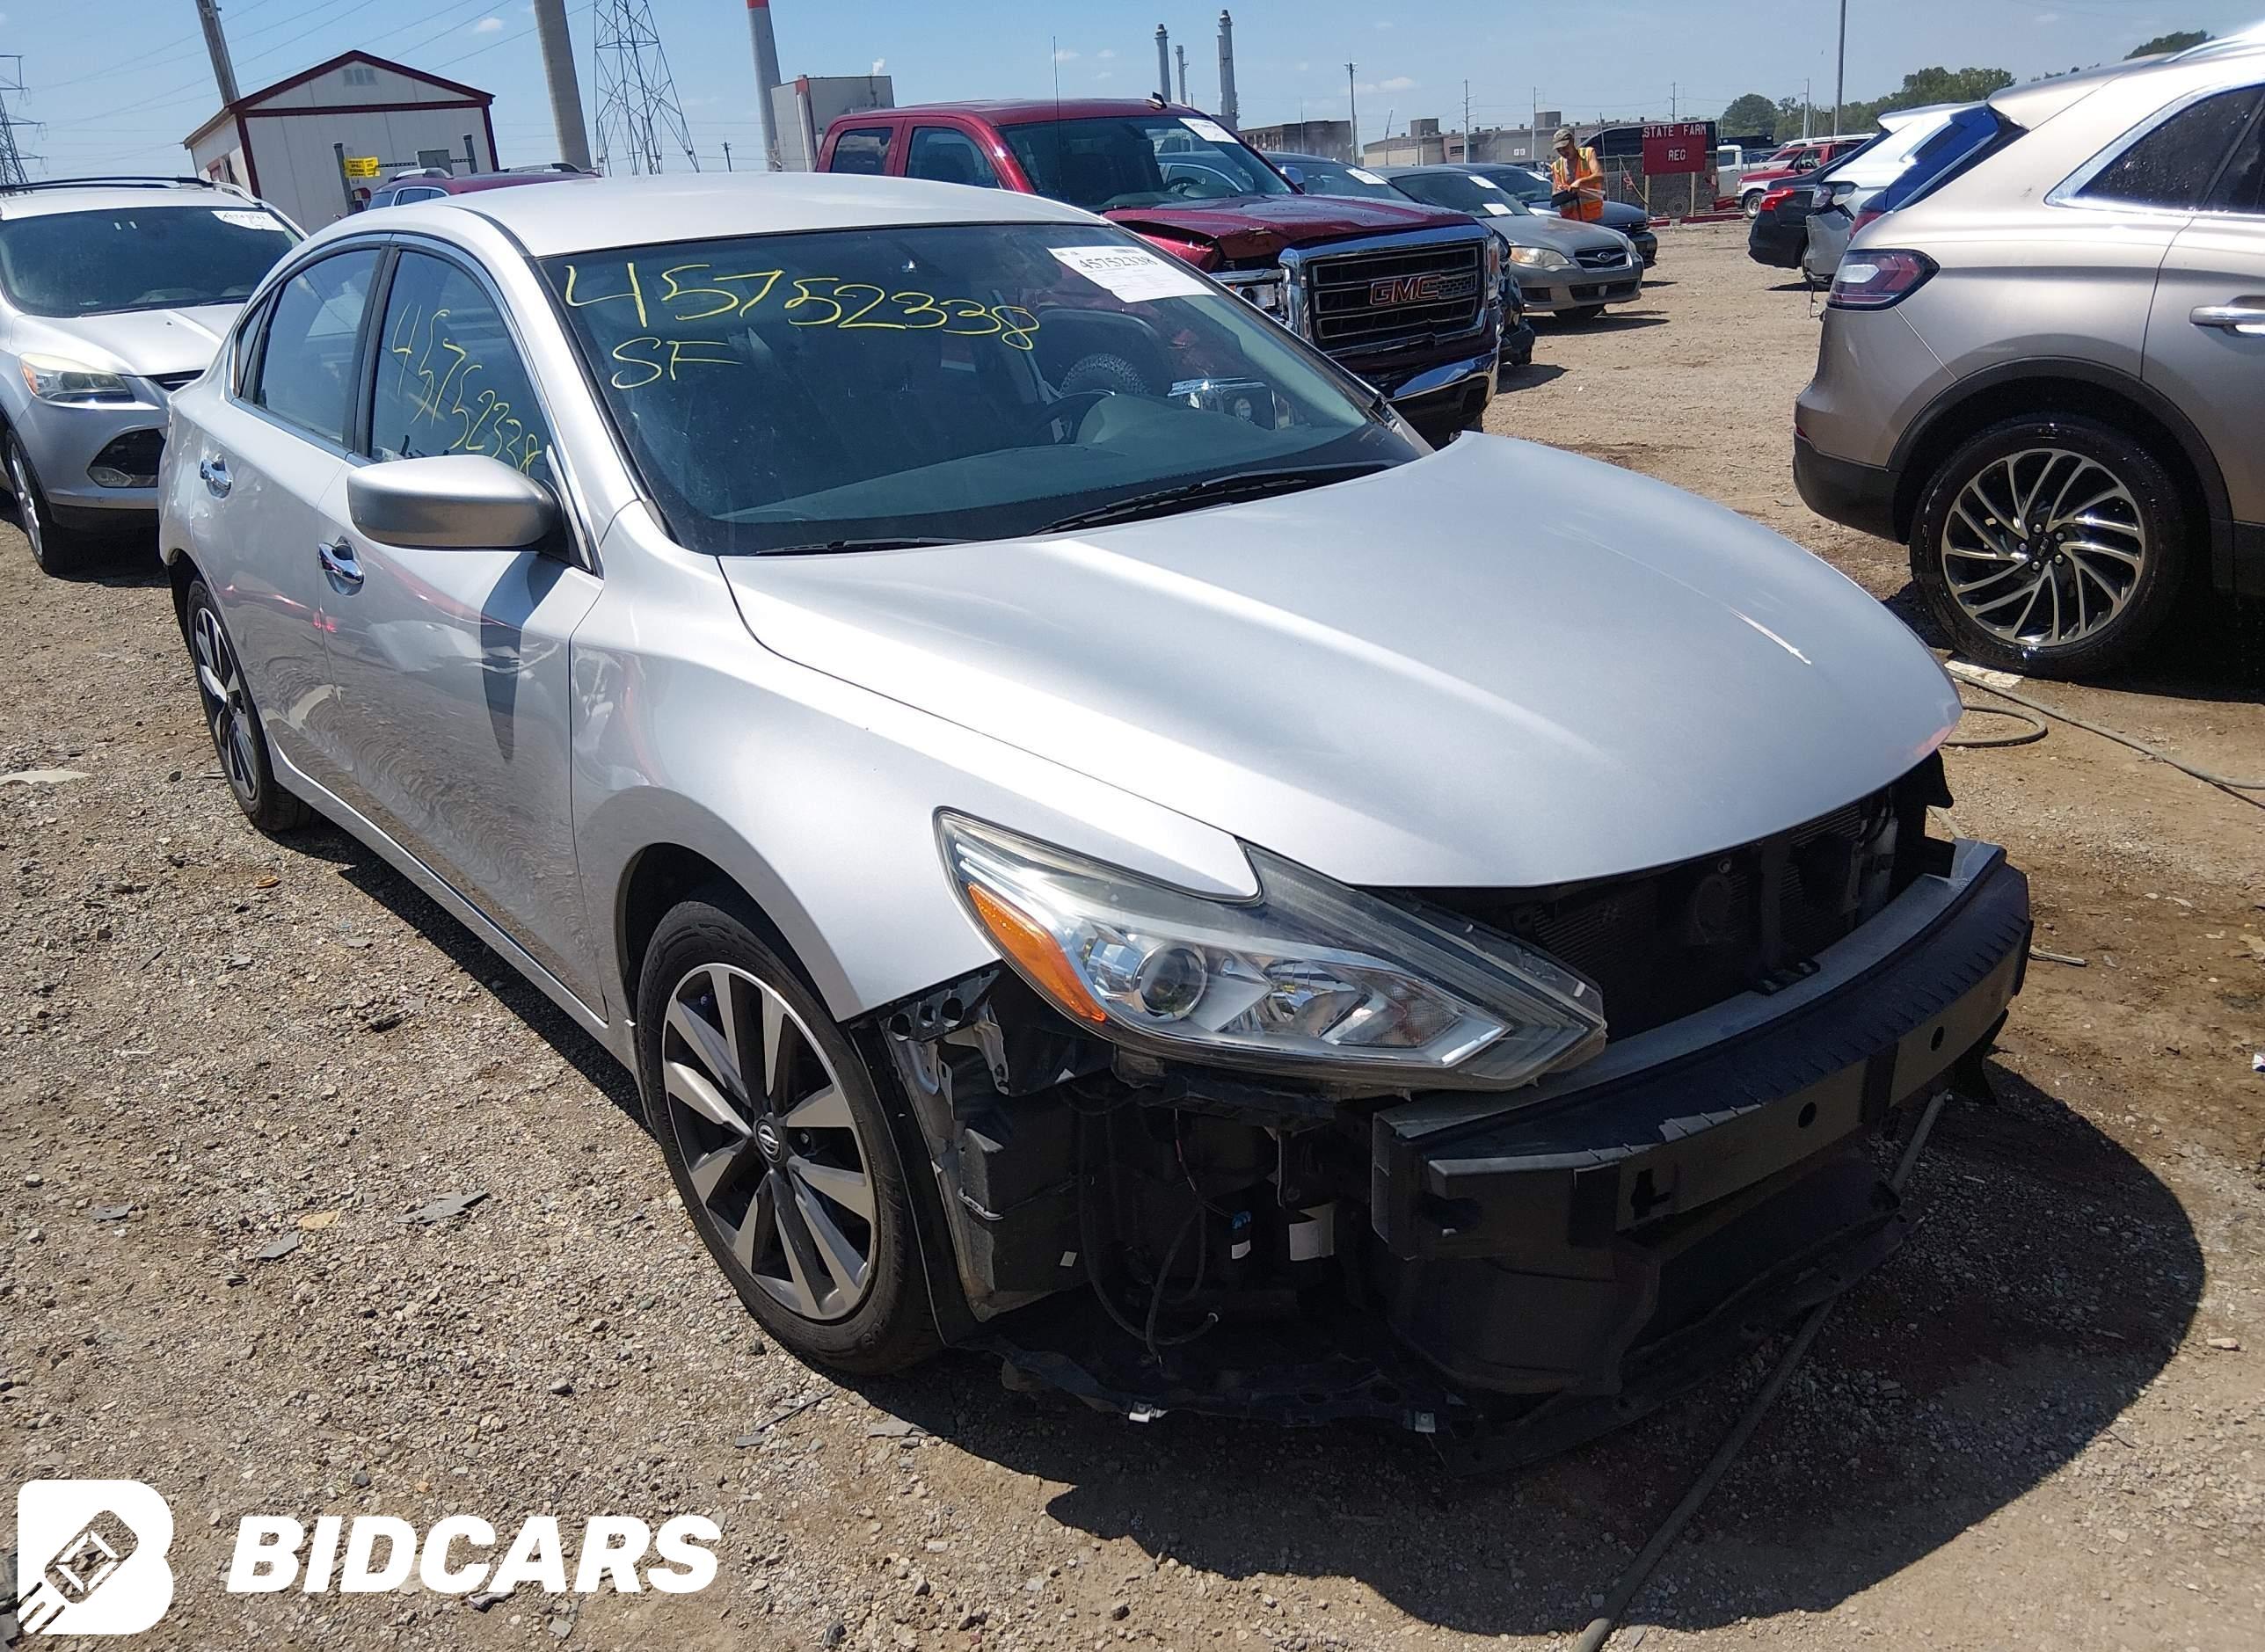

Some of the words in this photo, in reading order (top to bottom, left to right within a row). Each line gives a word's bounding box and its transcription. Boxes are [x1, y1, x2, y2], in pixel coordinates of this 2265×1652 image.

[1643, 125, 1674, 138] STATE
[1683, 123, 1707, 136] FARM
[564, 262, 1040, 351] 45752338
[1370, 273, 1441, 306] GMC
[611, 337, 744, 389] SF
